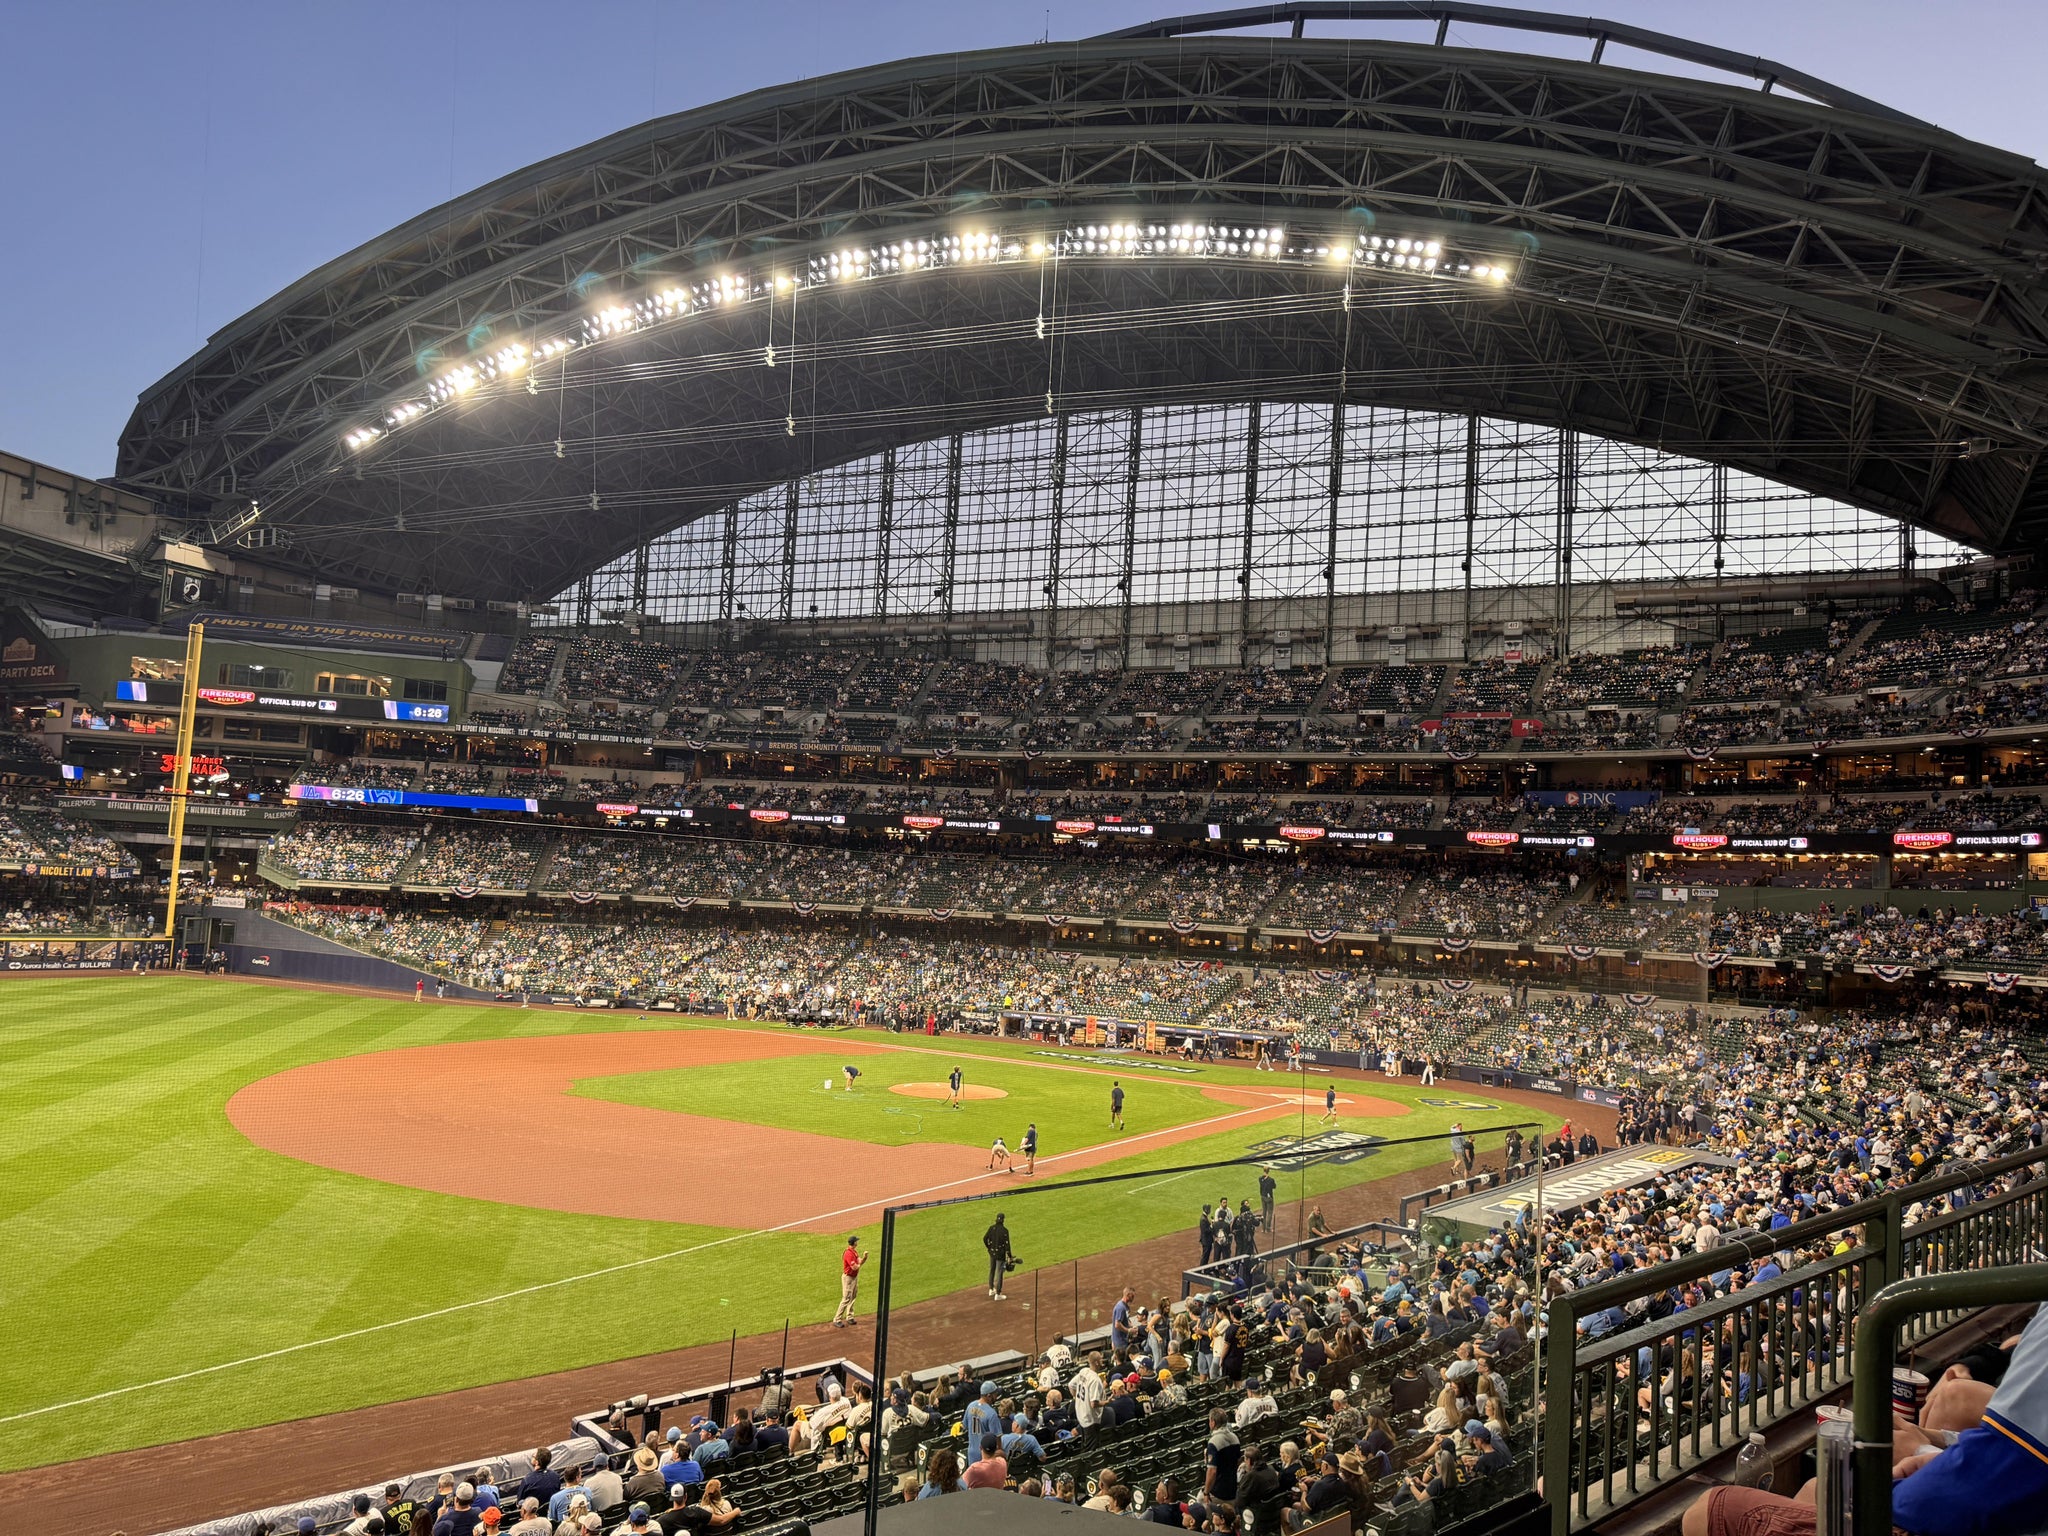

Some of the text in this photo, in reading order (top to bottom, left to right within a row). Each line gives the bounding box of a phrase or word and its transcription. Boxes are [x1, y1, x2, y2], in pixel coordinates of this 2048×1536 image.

[212, 618, 262, 627] MUST
[289, 624, 309, 632] IN
[313, 626, 346, 635] THE
[348, 629, 406, 640] FRONT
[409, 635, 456, 645] ROW!
[0, 665, 56, 678] PARTY DECK
[201, 690, 251, 699] FIREHOUSE
[259, 697, 317, 708] OFFICIAL SUB OF
[414, 707, 443, 719] 6:26
[768, 742, 881, 753] BREWERS COMMUNITY FOUNDATION
[192, 757, 223, 765] MARKET
[191, 764, 220, 775] HALL
[331, 789, 365, 801] 6:26
[1583, 792, 1615, 805] PNC
[58, 799, 97, 808] PALERMO'S
[107, 801, 131, 810] OFFICIAL
[132, 803, 154, 811] FROZEN
[154, 804, 170, 812] PIZZA
[40, 866, 94, 877] NICOLET LAW
[80, 961, 111, 969] BULLPEN
[387, 1502, 413, 1518] BRAUN
[397, 1513, 413, 1533] 8
